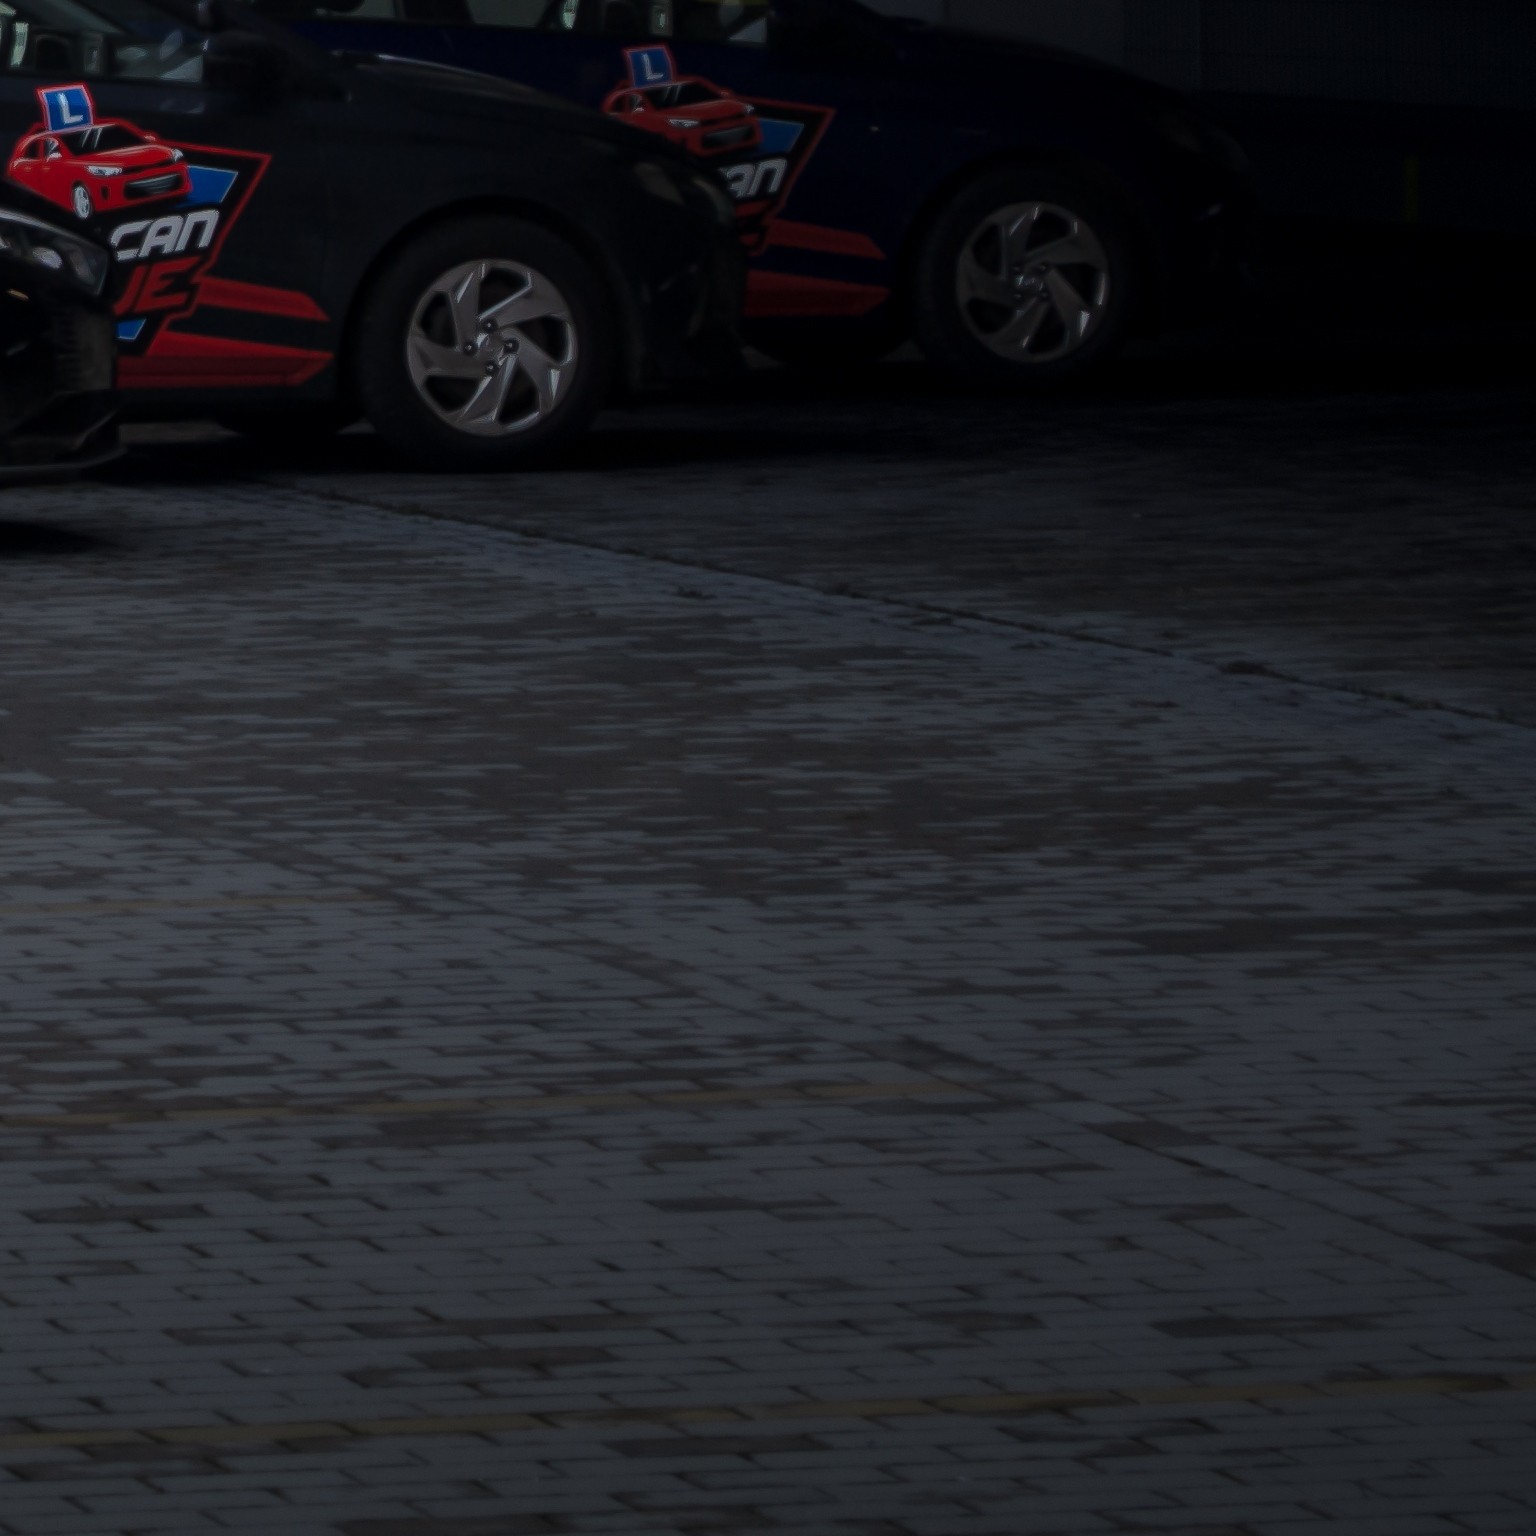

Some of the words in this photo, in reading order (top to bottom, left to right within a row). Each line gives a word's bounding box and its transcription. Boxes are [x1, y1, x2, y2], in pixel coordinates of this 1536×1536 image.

[641, 53, 664, 81] L
[58, 92, 84, 123] L
[717, 156, 788, 201] AN
[109, 207, 220, 263] CAN
